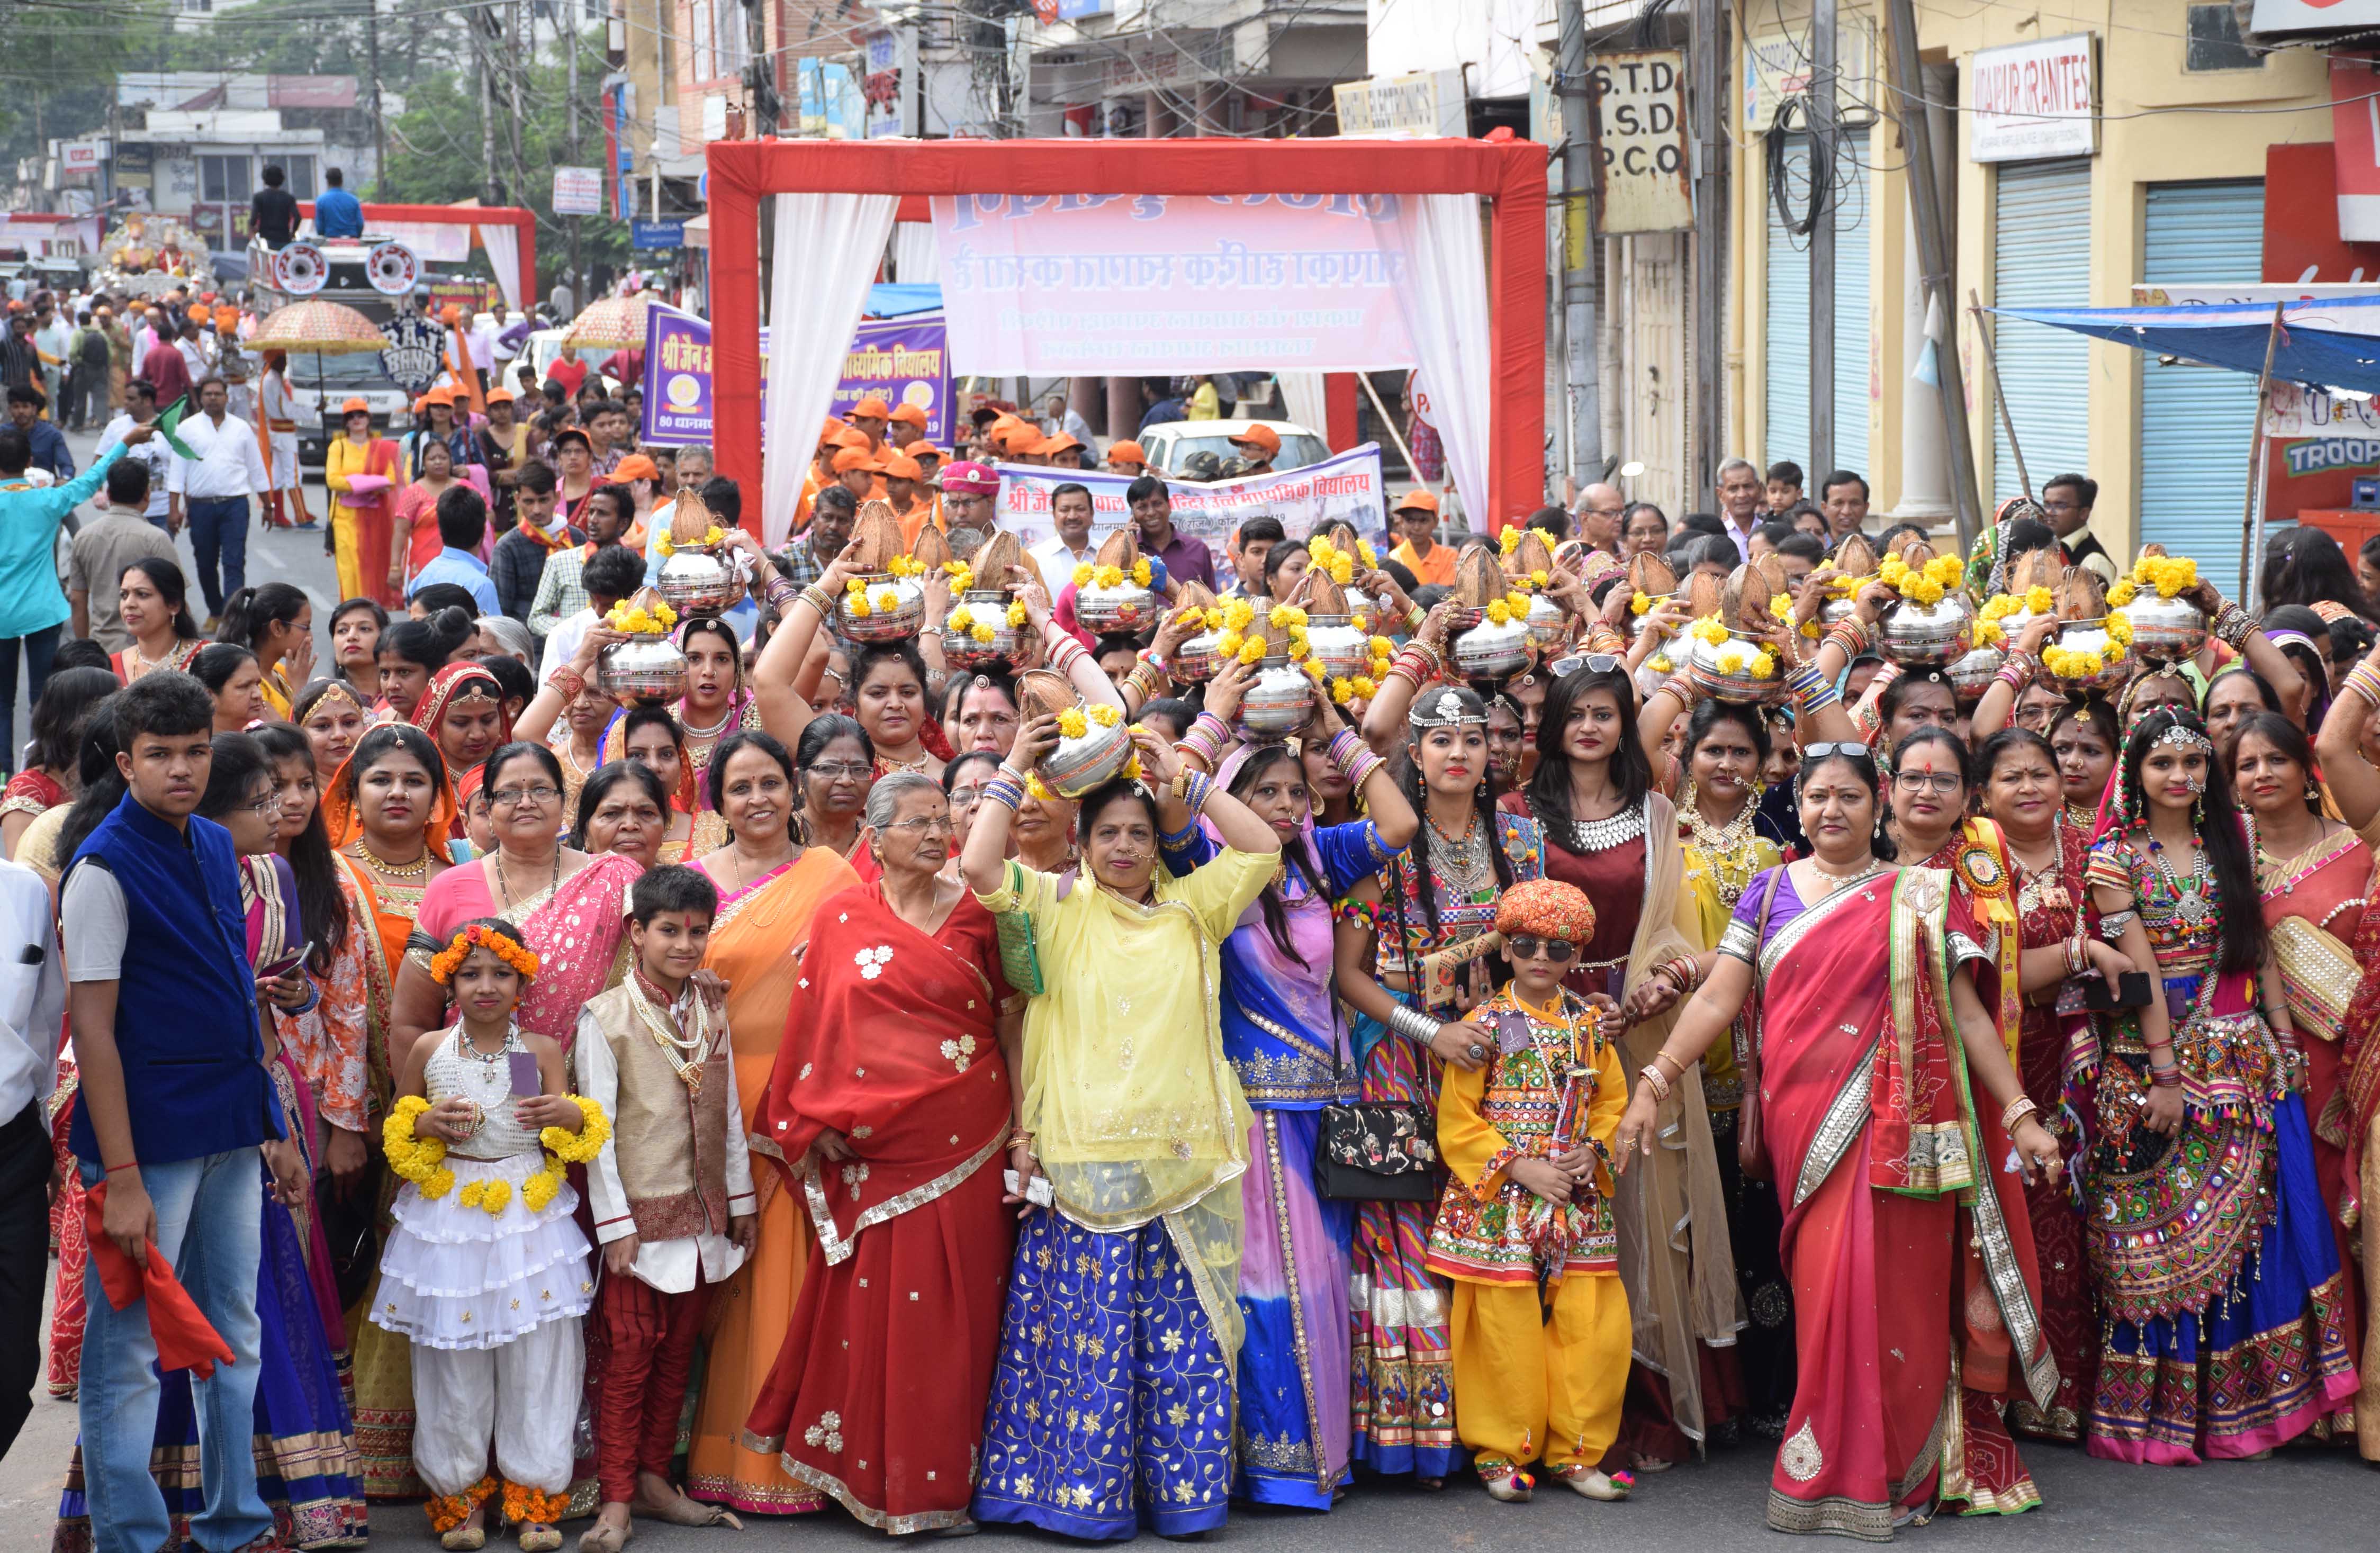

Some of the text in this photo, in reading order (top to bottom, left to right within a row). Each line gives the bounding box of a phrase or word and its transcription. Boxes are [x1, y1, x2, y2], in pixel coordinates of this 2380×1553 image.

[660, 416, 672, 428] 80
[1007, 486, 1028, 512] श्री
[1032, 486, 1053, 512] जै
[1312, 473, 1371, 498] विद्यालय
[1504, 1037, 1522, 1052] ONE
